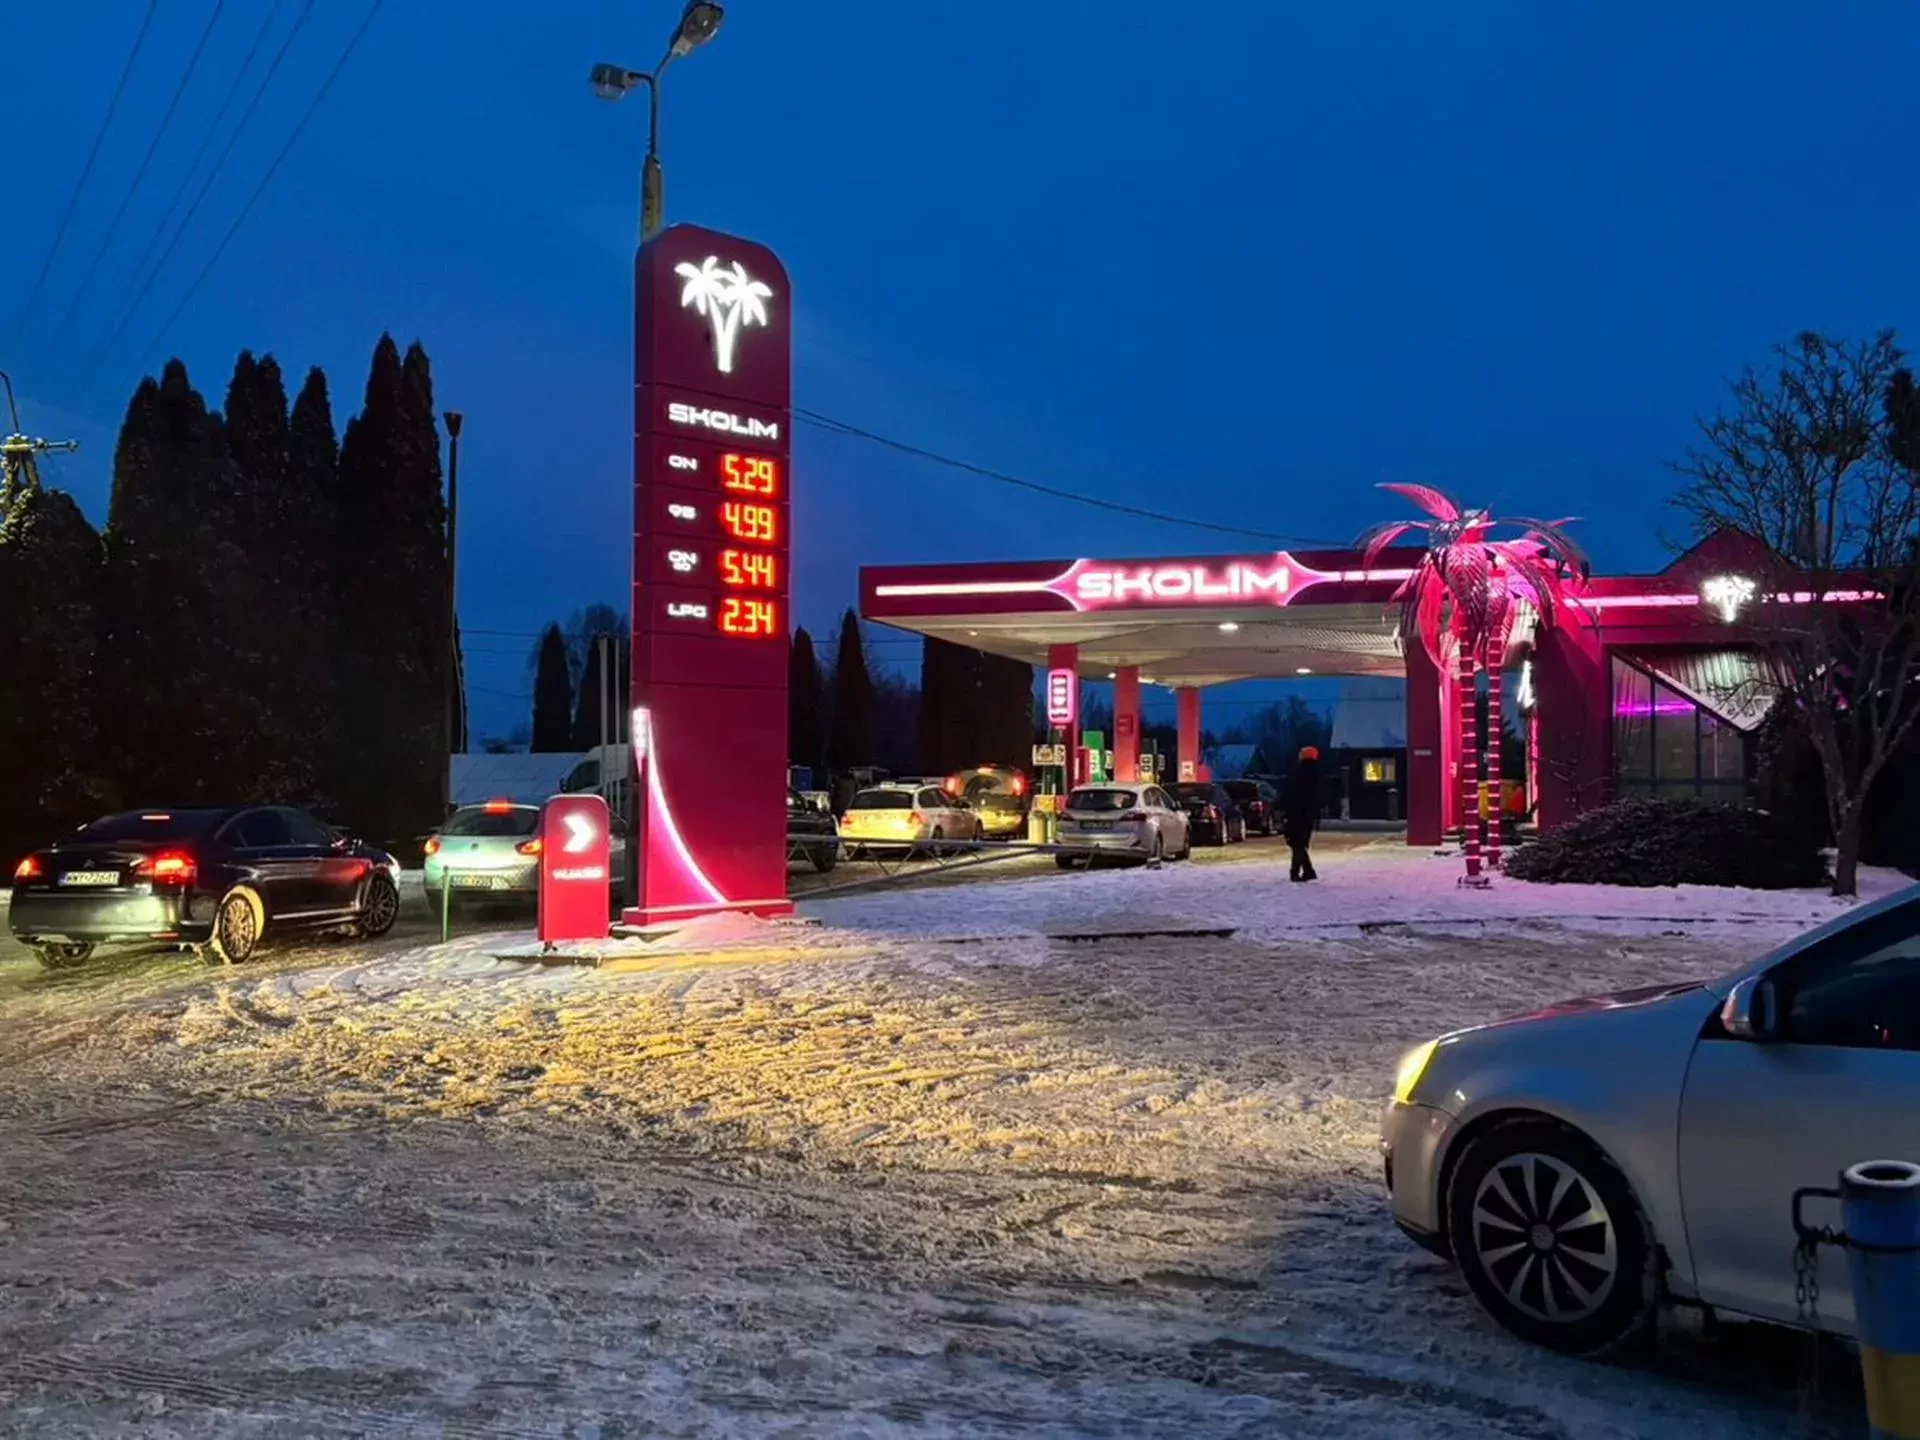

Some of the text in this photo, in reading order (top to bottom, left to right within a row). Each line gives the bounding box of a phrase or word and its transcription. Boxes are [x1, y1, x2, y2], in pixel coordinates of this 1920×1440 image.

[668, 403, 778, 438] SKOLIM
[668, 454, 773, 493] ON 5.29
[724, 502, 773, 540] 4.99
[668, 551, 773, 587] ON 5.44
[1077, 564, 1289, 599] SKOLIM
[667, 598, 774, 635] LPG 2.34
